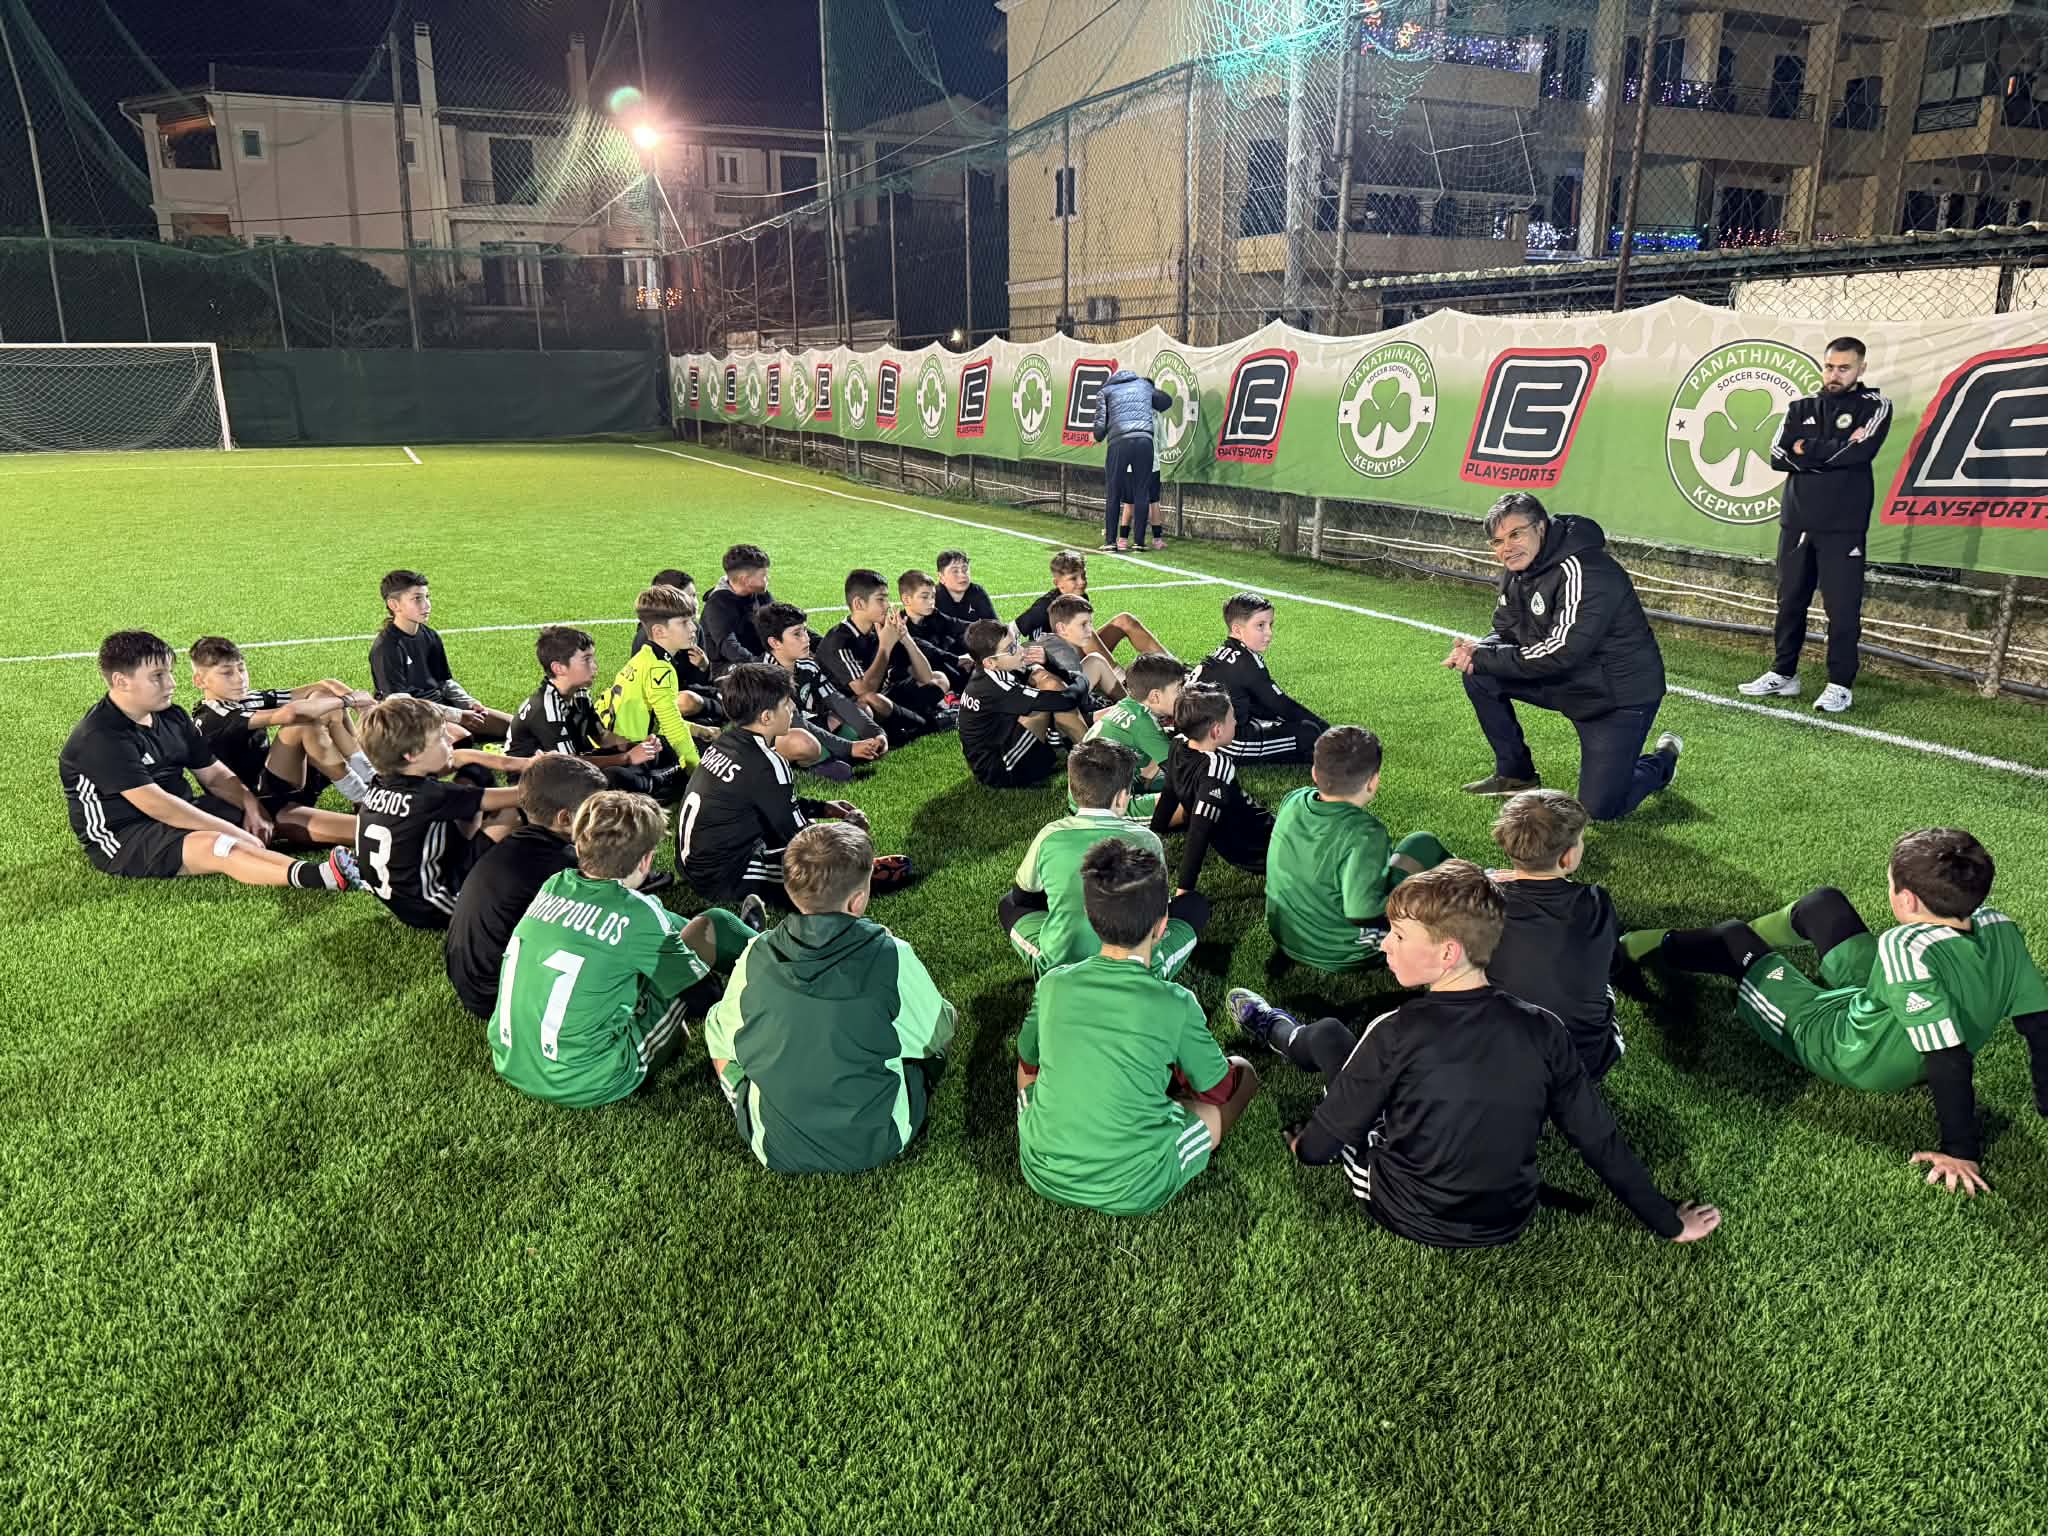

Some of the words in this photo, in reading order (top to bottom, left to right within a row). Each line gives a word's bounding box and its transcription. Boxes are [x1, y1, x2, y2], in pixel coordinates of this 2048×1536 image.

[1348, 348, 1431, 388] PANATHINAIKOS
[1689, 349, 1824, 398] PANATHINAIKO
[1716, 371, 1753, 392] SOCCER
[1755, 371, 1797, 397] SCHOOLS
[1465, 462, 1558, 481] PLAYSPORTS
[1889, 500, 2048, 519] PLAYSPORT
[500, 935, 586, 1062] 11
